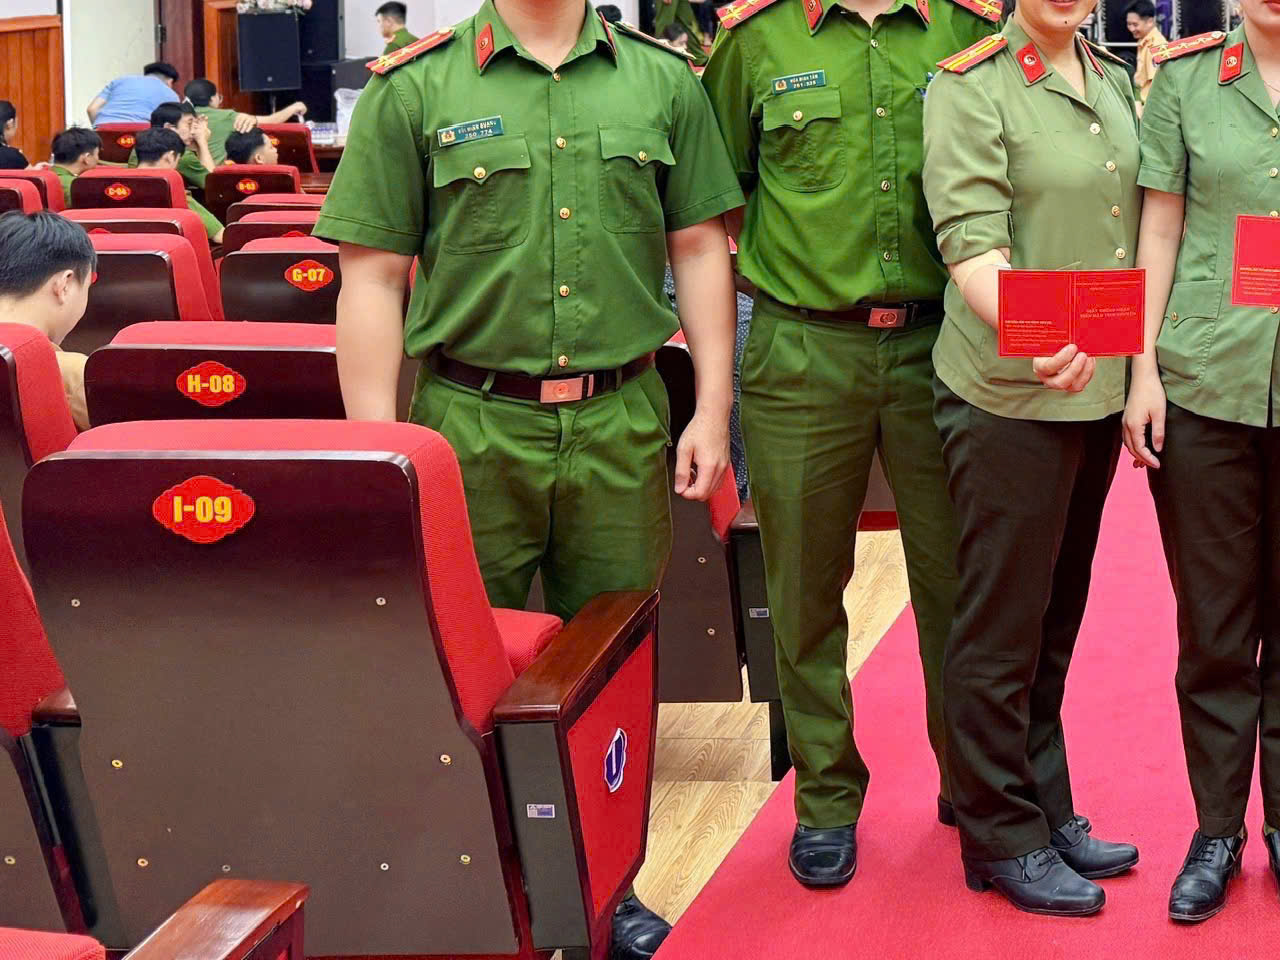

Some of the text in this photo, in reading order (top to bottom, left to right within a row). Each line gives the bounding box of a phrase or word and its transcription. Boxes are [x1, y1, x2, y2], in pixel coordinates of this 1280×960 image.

[292, 268, 326, 282] G-07
[187, 374, 235, 393] H-08
[172, 496, 232, 523] I-09
